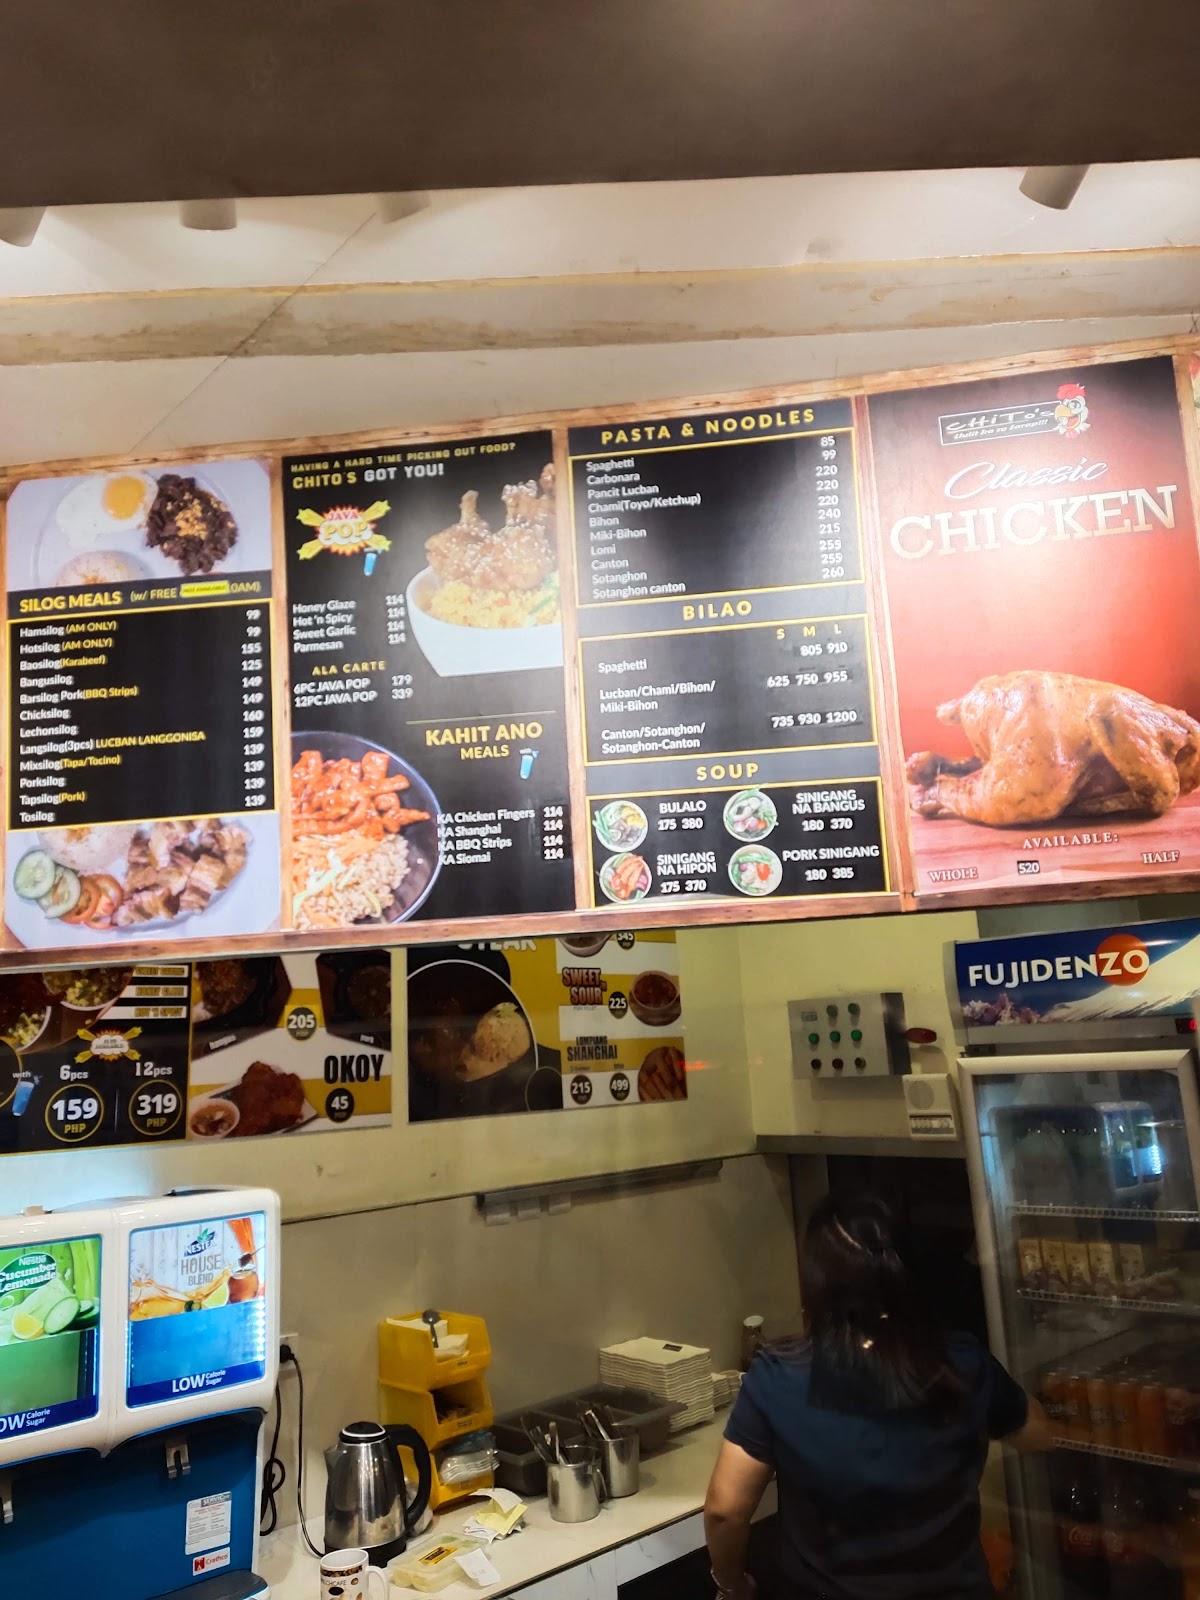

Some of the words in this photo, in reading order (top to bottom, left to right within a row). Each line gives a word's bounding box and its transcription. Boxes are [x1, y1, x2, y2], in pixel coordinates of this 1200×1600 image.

[601, 426, 671, 445] PASTA
[681, 423, 694, 437] &
[705, 409, 814, 434] NOODLES
[821, 437, 835, 447] 85
[291, 461, 329, 472] HAVING
[345, 457, 372, 467] HARD
[377, 454, 402, 464] TIME
[407, 450, 449, 461] PICKING
[454, 447, 475, 457] OUT
[480, 443, 516, 454] FOOD?
[823, 450, 836, 460] 99
[586, 458, 634, 472] Spaghetti
[816, 465, 837, 476] 220
[364, 467, 397, 481] GOT
[405, 464, 444, 478] YOU!
[587, 472, 640, 485] Carbonara
[944, 457, 1109, 500] Classic
[588, 488, 620, 499] Pancit
[622, 484, 659, 496] Lucban
[817, 480, 838, 491] 220
[818, 495, 838, 506] 220
[818, 509, 840, 519] 240
[589, 516, 619, 527] Bihon
[820, 523, 840, 533] 215
[890, 485, 1178, 560] CHICKEN
[591, 528, 646, 542] Miki-Bihon
[591, 545, 615, 556] Lomi
[592, 558, 628, 570] Canton
[592, 570, 647, 585] Sotanghon
[822, 567, 843, 579] 260
[593, 585, 647, 599] Sotanghon
[650, 581, 685, 593] canton
[20, 593, 66, 612] SILOG
[69, 591, 122, 609] MEALS
[151, 588, 176, 599] FREE
[293, 603, 325, 615] Honey
[327, 599, 355, 611] Glaze
[247, 610, 260, 620] 99
[683, 601, 752, 621] BILAO
[20, 626, 63, 637] Hamsilog
[66, 623, 85, 634] (AM
[88, 621, 117, 632] ONLY)
[247, 627, 261, 637] 99
[294, 628, 324, 640] Sweet
[326, 625, 355, 637] Garlic
[20, 642, 60, 654] Hotsilog
[62, 640, 81, 650] (AM
[83, 638, 113, 648] ONLY)
[242, 644, 261, 654] 155
[294, 641, 343, 652] Parmesan
[800, 643, 822, 656] 805
[827, 642, 847, 653] 910
[242, 660, 262, 670] 125
[312, 664, 337, 676] ALA
[343, 661, 386, 673] CARTE
[598, 659, 647, 673] Spaghetti
[20, 675, 73, 688] Bangusilog
[242, 677, 262, 687] 149
[392, 675, 412, 686] 179
[768, 675, 789, 688] 625
[796, 674, 818, 686] 750
[824, 671, 847, 683] 955
[243, 693, 263, 704] 149
[600, 700, 658, 712] Miki-Bihon
[20, 708, 70, 721] Chicksilog
[243, 710, 263, 721] 160
[772, 716, 793, 728] 735
[798, 713, 820, 726] 930
[826, 711, 857, 723] 1200
[20, 724, 78, 738] Lechonsilog
[243, 727, 263, 738] 159
[426, 726, 490, 746] KAHIT
[496, 722, 543, 741] ANO
[96, 737, 136, 748] LUCBAN
[244, 744, 264, 754] 139
[602, 738, 700, 754] Sotanghon-Canton
[461, 745, 509, 760] MEALS
[244, 761, 264, 771] 139
[697, 762, 758, 781] SOUP
[20, 776, 65, 788] Porksilog
[244, 778, 265, 789] 139
[245, 795, 265, 806] 139
[796, 790, 856, 804] SINIGANG
[659, 800, 706, 814] BULALO
[792, 802, 812, 814] NA
[813, 800, 865, 813] BANGUS
[20, 811, 54, 822] Tosilog
[455, 811, 495, 822] Chicken
[498, 808, 535, 822] Fingers
[456, 824, 501, 837] Shanghai
[658, 819, 677, 831] 175
[682, 818, 703, 830] 380
[802, 820, 824, 831] 180
[831, 818, 852, 830] 370
[456, 839, 481, 851] BBQ
[482, 837, 512, 848] Strips
[1023, 833, 1118, 849] AVAILABLE:
[456, 852, 491, 864] Siomai
[657, 852, 715, 866] SINIGANG
[782, 849, 818, 861] PORK
[820, 846, 879, 859] SINIGANG
[1143, 850, 1180, 864] HALF
[657, 864, 678, 876] NA
[679, 861, 716, 874] HIPON
[805, 869, 827, 881] 180
[832, 867, 854, 879] 385
[1018, 862, 1039, 873] 520
[929, 867, 978, 883] WHOLE
[661, 882, 680, 893] 175
[685, 879, 706, 891] 370
[969, 949, 1149, 989] FUJIDENZO
[562, 967, 601, 986] SWEET
[571, 986, 602, 1005] SOUR
[610, 998, 626, 1009] 225
[288, 1015, 315, 1029] 205
[568, 1045, 617, 1061] SHANGHAI
[60, 1065, 88, 1081] 6pcs
[135, 1062, 172, 1077] 12pcs
[324, 1054, 384, 1084] OKOY
[572, 1083, 590, 1094] 215
[611, 1080, 628, 1091] 499
[52, 1099, 98, 1121] 159
[137, 1093, 177, 1115] 319
[331, 1096, 348, 1110] 45
[64, 1123, 86, 1134] PHP
[147, 1118, 167, 1127] PHP
[181, 1255, 221, 1273] HOUSE
[188, 1273, 213, 1286] BLEND
[205, 1369, 226, 1378] Calorie
[173, 1373, 205, 1392] LOW
[205, 1377, 222, 1386] Sugar
[27, 1408, 50, 1419] Calorie
[26, 1417, 46, 1427] Sugar
